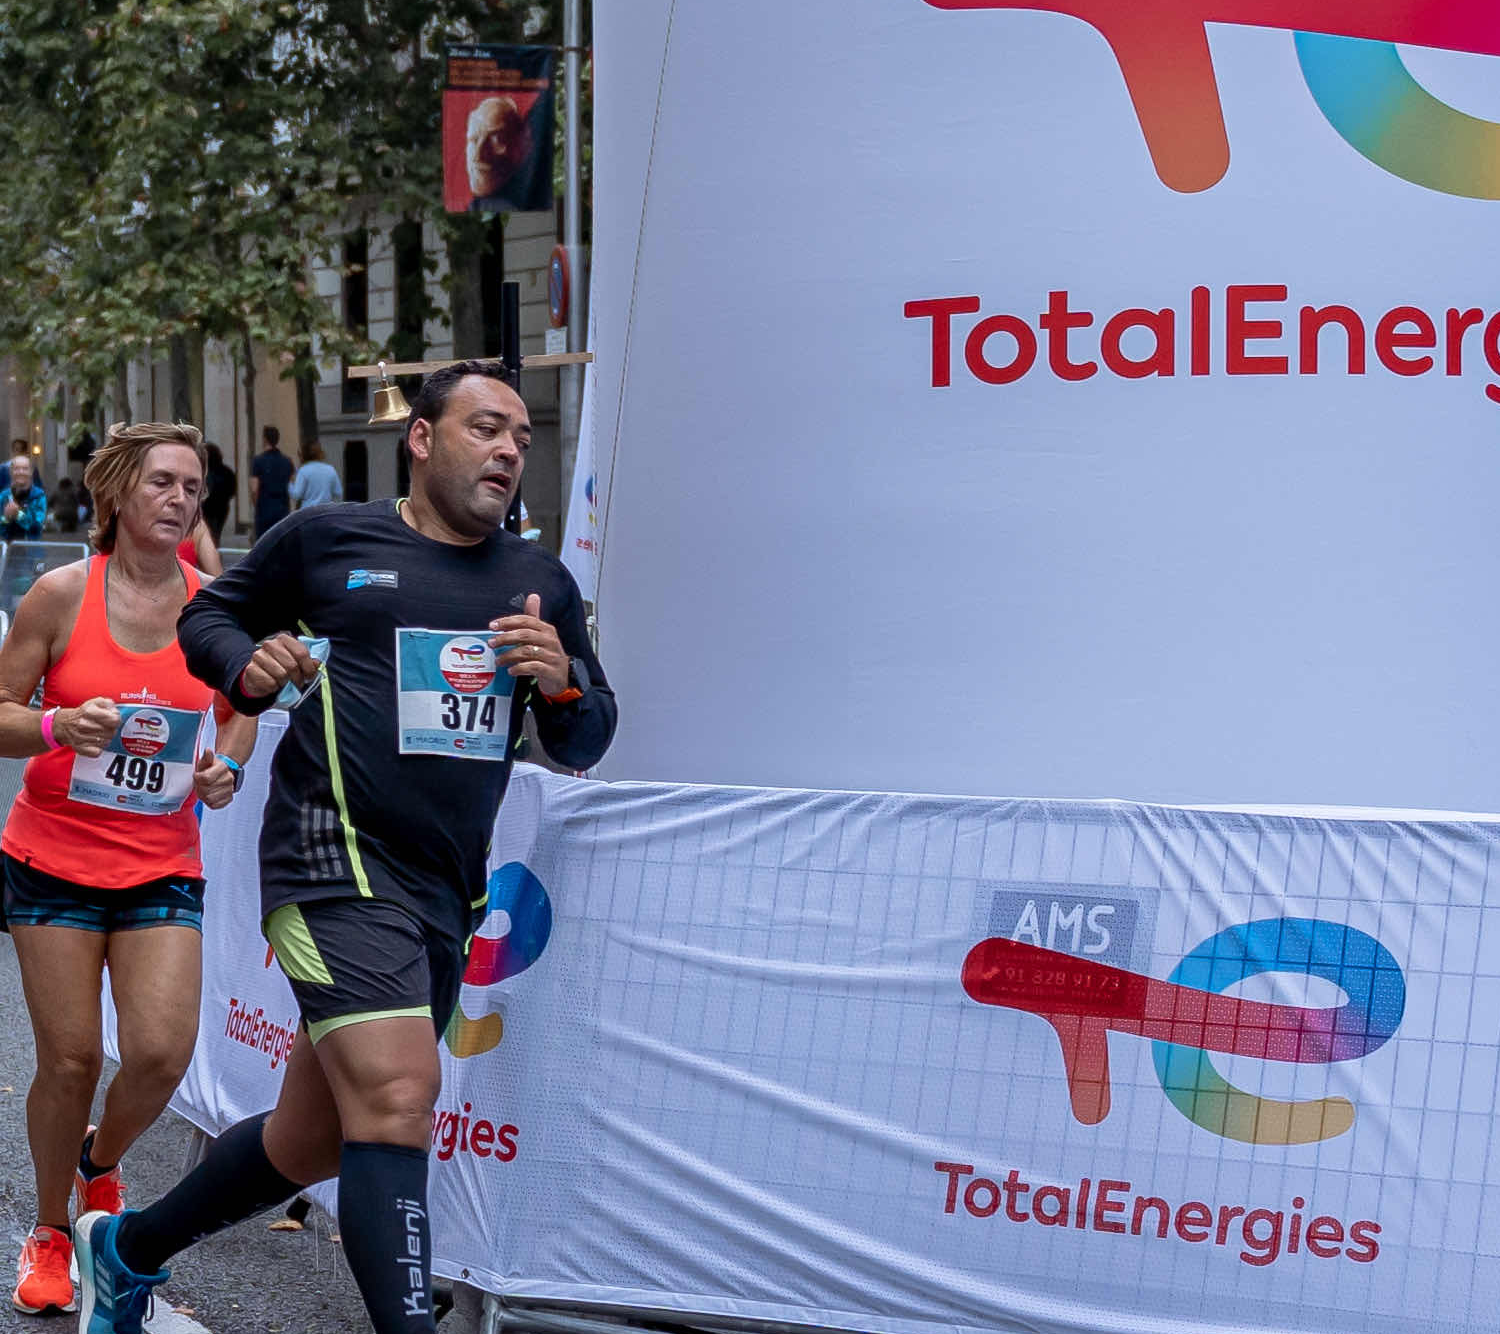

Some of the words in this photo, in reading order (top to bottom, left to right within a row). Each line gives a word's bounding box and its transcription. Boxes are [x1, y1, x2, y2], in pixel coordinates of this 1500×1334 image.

[440, 693, 497, 733] 374
[105, 754, 165, 793] 499
[1010, 899, 1115, 954] AMS
[224, 998, 296, 1069] TotalEnergie
[934, 1162, 1382, 1266] TotalEnergies
